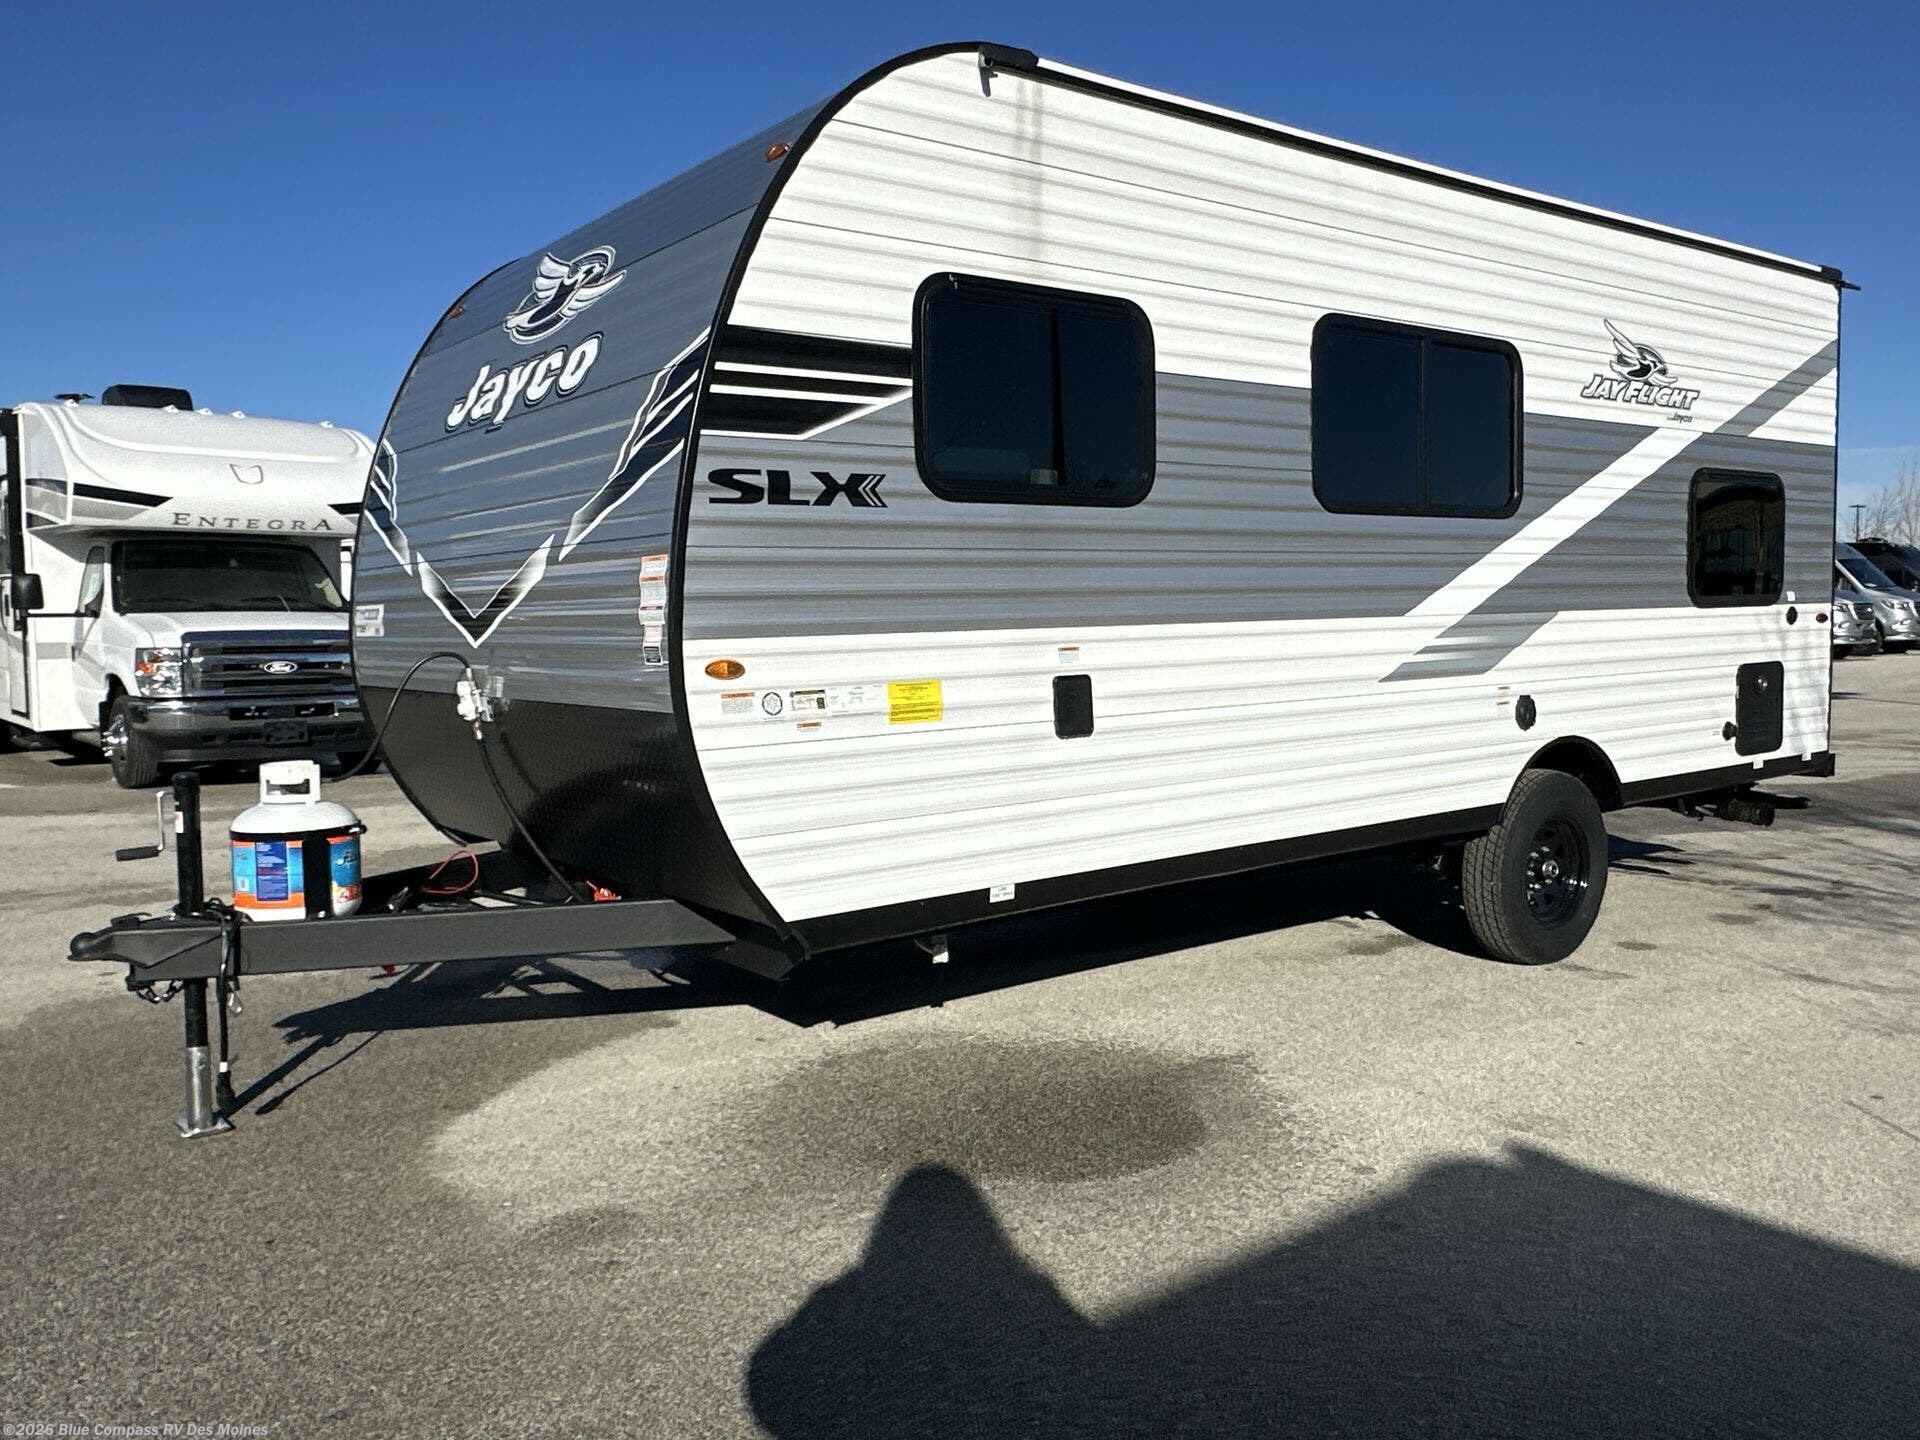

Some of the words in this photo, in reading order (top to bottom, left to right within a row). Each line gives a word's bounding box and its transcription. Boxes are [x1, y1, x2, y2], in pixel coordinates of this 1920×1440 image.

[446, 332, 603, 432] Jayco
[707, 468, 887, 508] SLX
[172, 512, 332, 531] ENTEGRA
